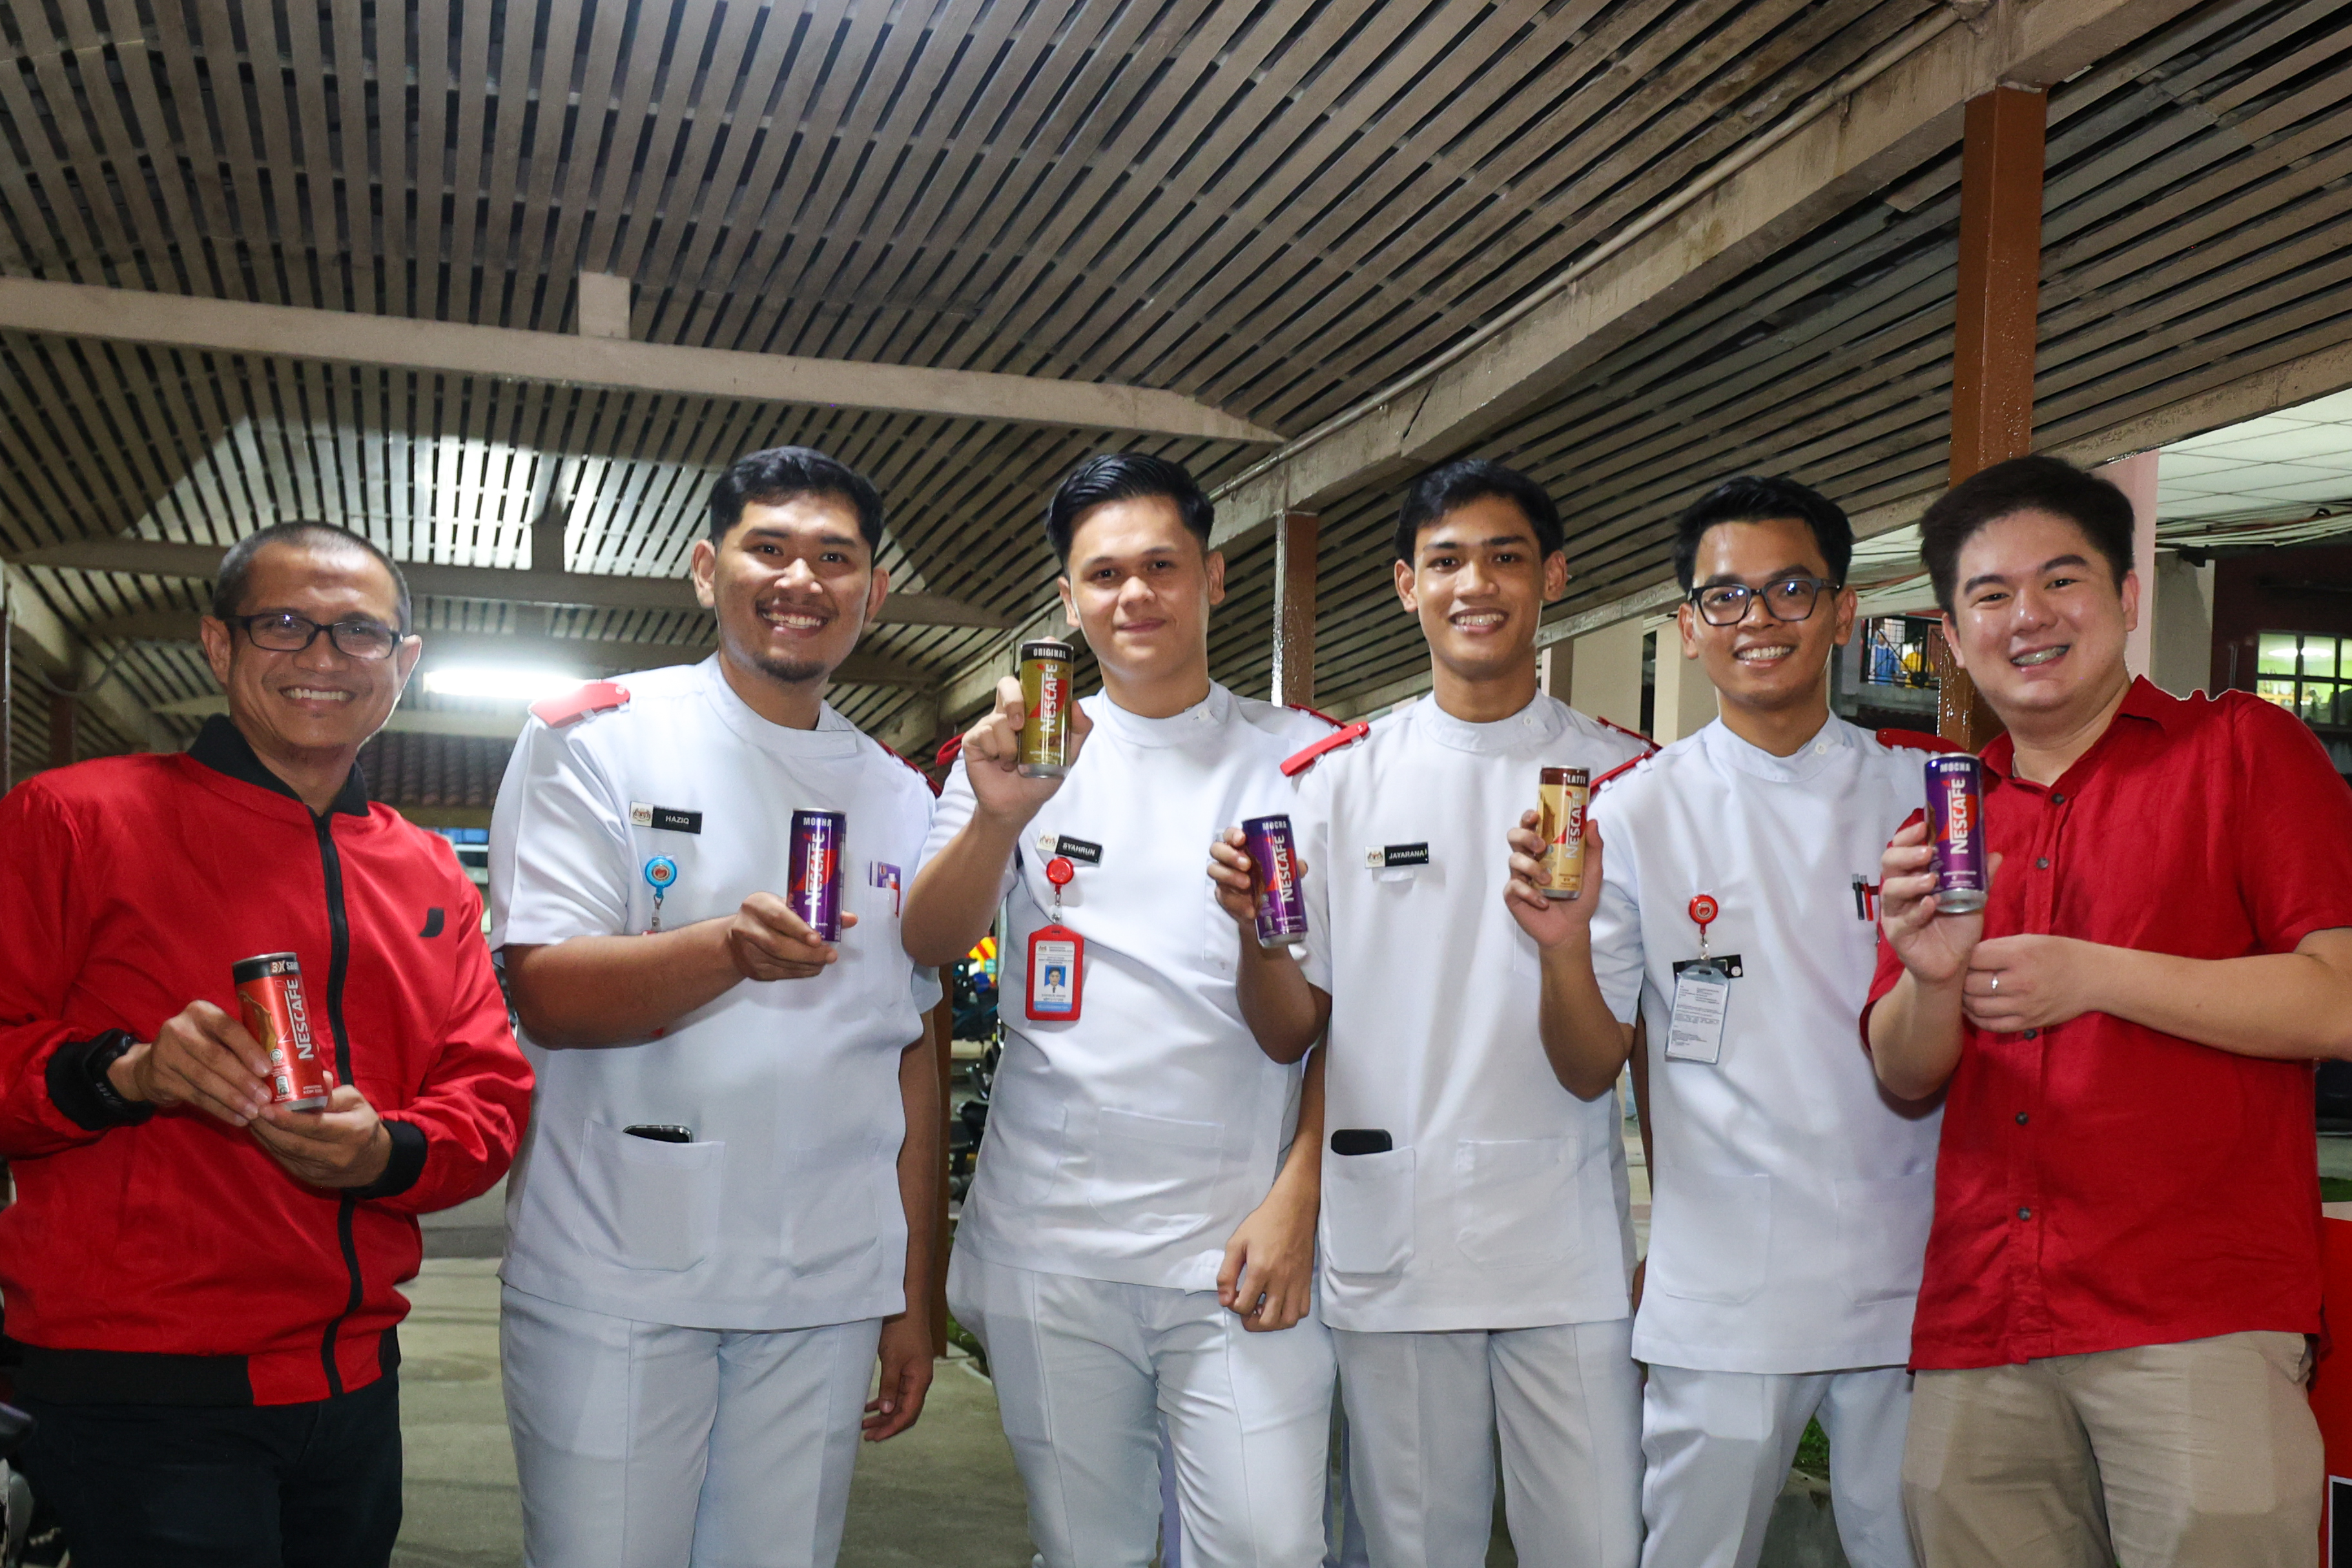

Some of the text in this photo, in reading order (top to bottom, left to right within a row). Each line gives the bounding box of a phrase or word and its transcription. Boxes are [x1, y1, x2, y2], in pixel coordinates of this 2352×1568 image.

[1033, 648, 1066, 659] ORIGINAL
[1939, 762, 1971, 772] MOCHA
[665, 814, 690, 825] HAZIQ
[1262, 821, 1287, 831] MOCHA
[1062, 841, 1096, 856] SYAHRUN
